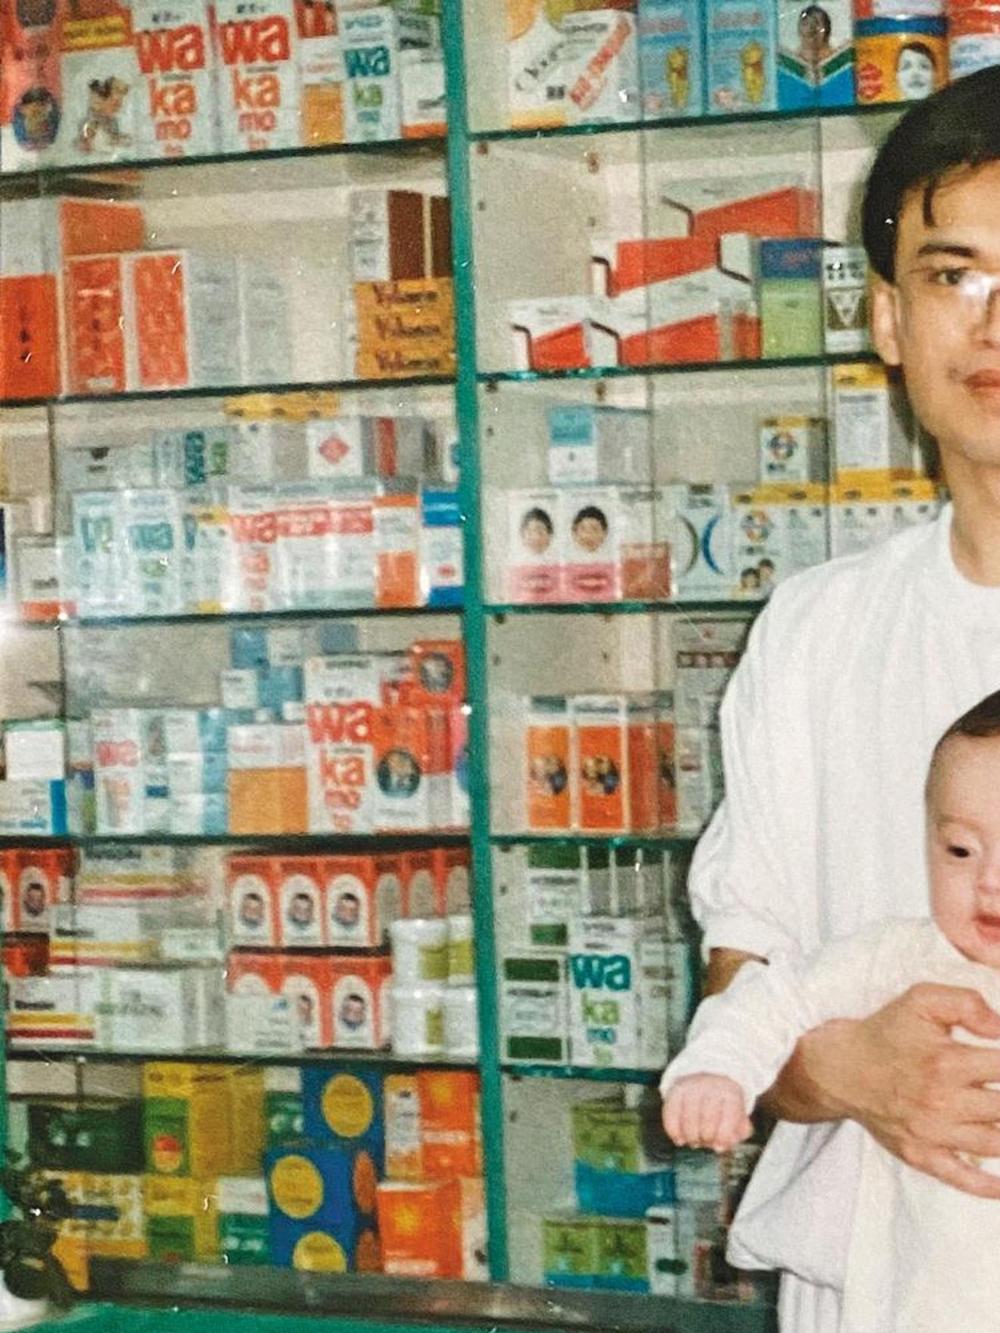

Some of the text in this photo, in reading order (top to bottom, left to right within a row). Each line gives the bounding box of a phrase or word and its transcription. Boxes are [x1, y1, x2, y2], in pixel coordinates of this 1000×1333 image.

[136, 24, 205, 73] wa
[221, 15, 290, 65] wa
[148, 77, 197, 118] ka
[233, 68, 281, 110] ka
[308, 702, 371, 743] wa
[320, 748, 366, 786] ka
[570, 954, 631, 991] wa
